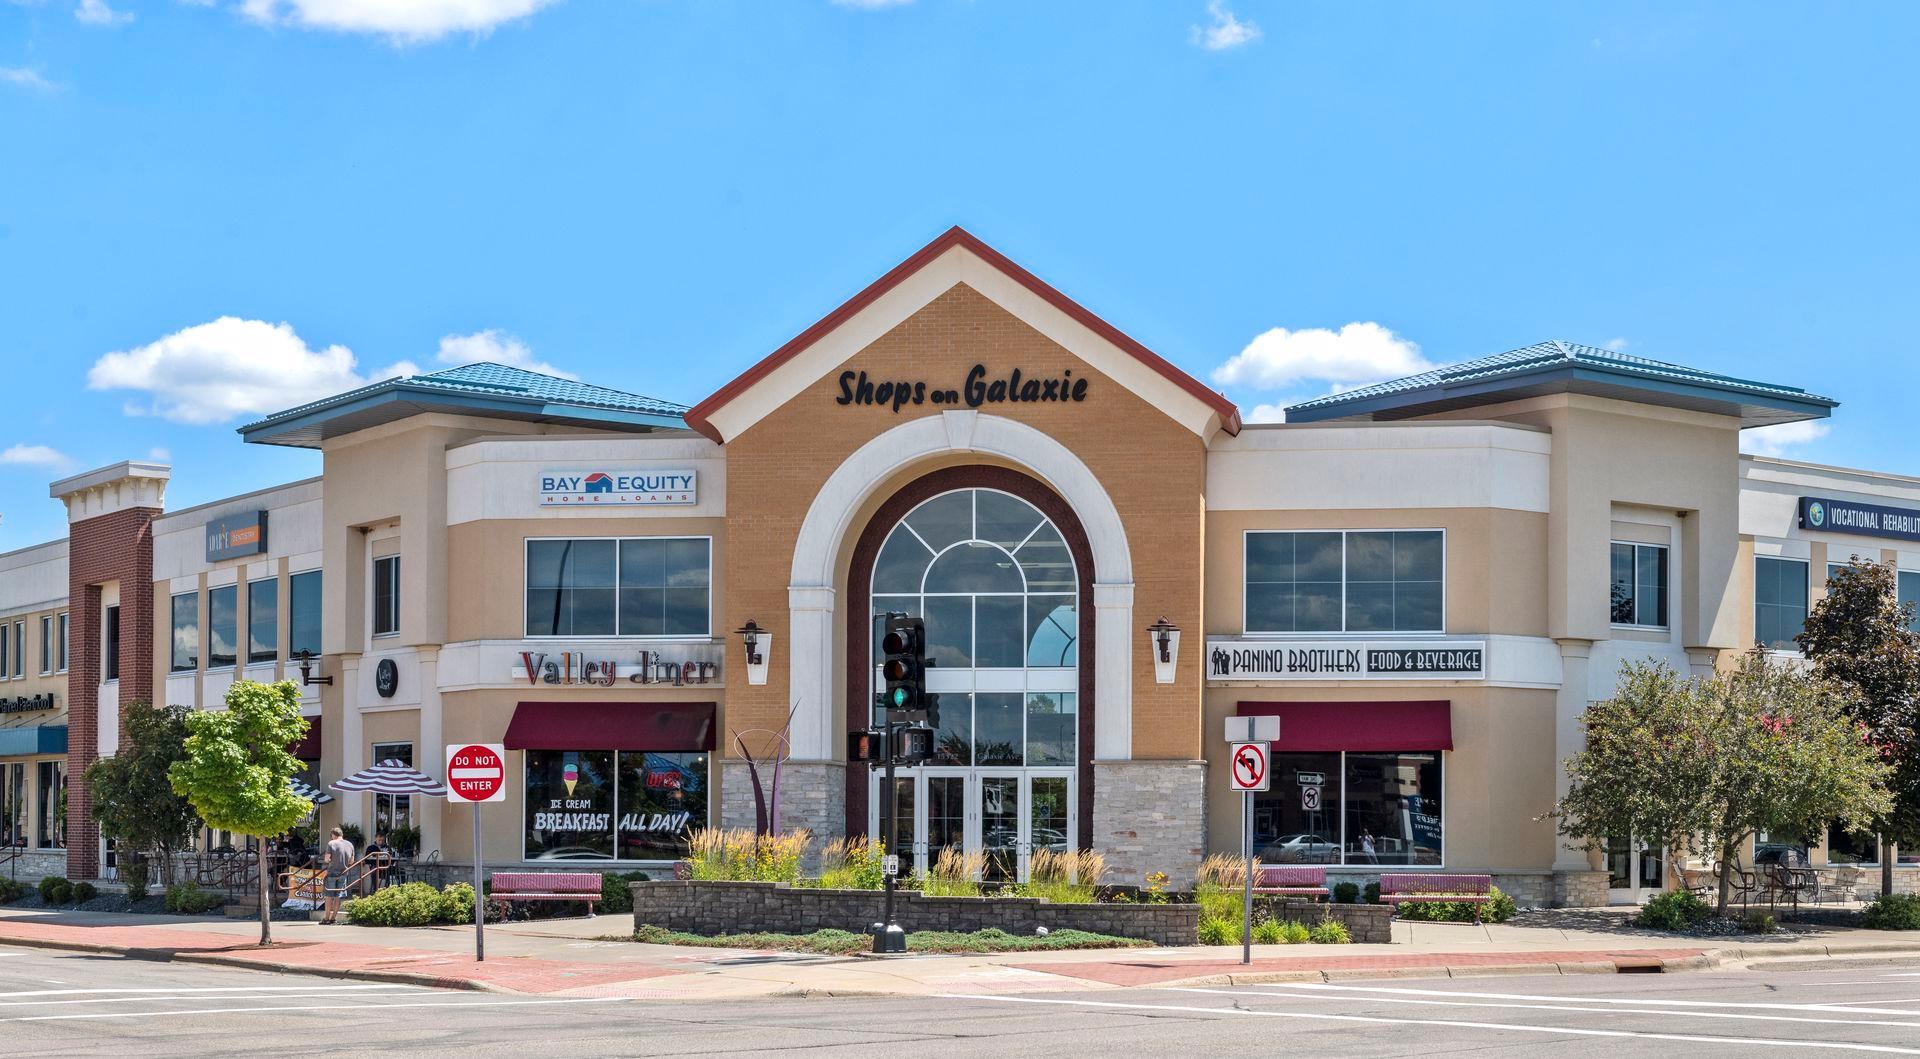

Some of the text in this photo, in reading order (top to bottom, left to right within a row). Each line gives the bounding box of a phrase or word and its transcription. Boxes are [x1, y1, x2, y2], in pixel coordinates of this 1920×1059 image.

[836, 364, 1088, 413] Shops on Galaxie
[542, 475, 692, 492] BAY EQUITY
[1831, 507, 1879, 529] VOCATIONAL
[519, 650, 716, 687] Valley diner
[1233, 649, 1361, 673] PANINO BROTHERS
[1370, 651, 1480, 670] FOOD & BEVERAGE
[455, 755, 496, 766] DO NOT
[977, 752, 1004, 760] Galaxie
[460, 781, 492, 791] ENTER
[550, 799, 591, 809] ICE CREAM
[535, 811, 689, 834] BREAKFAST ALL DAY!
